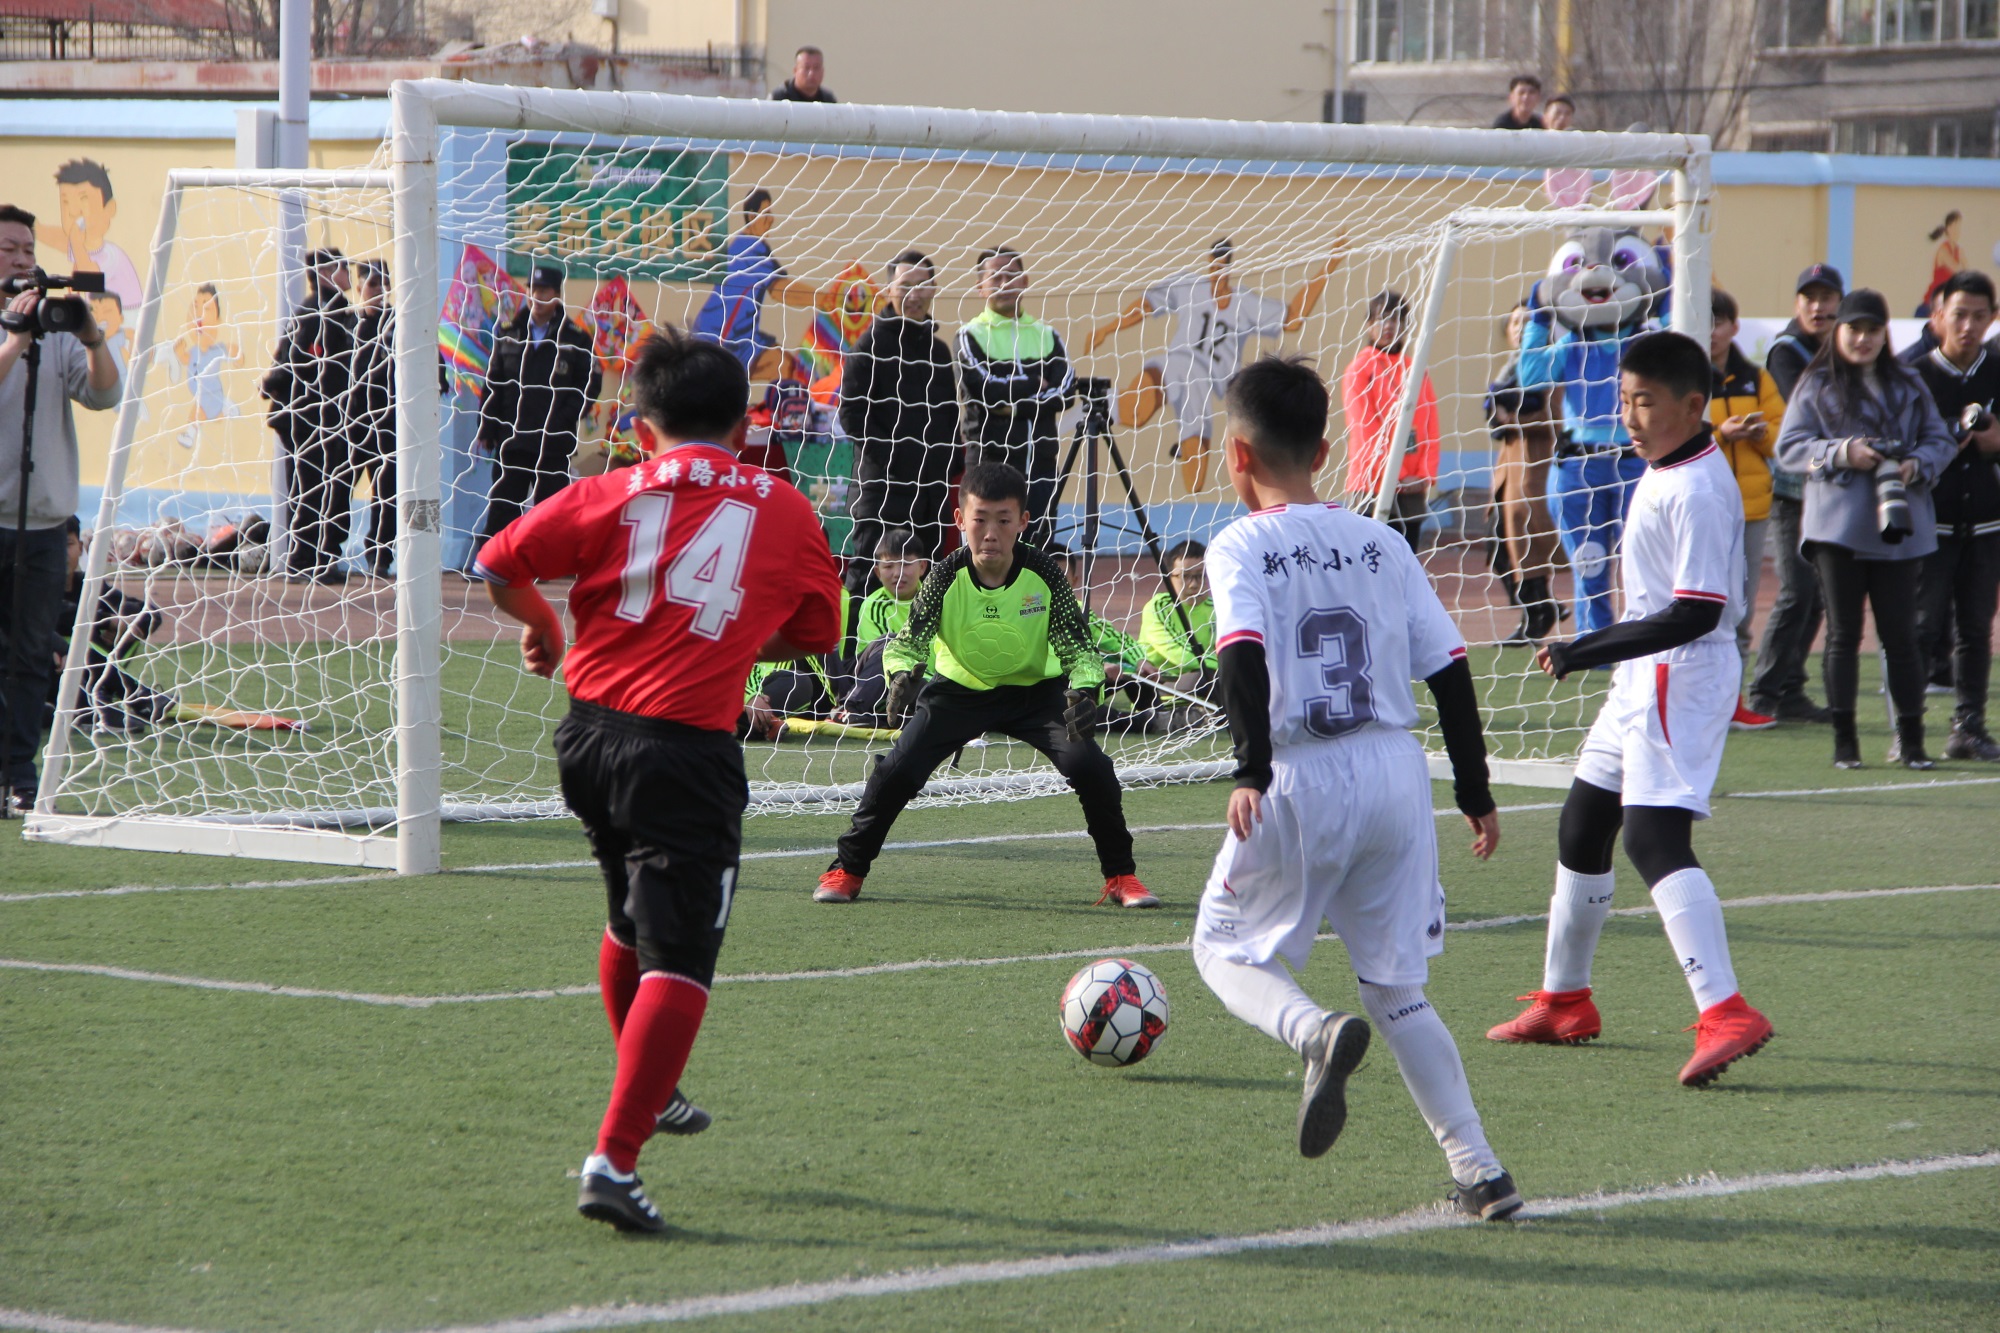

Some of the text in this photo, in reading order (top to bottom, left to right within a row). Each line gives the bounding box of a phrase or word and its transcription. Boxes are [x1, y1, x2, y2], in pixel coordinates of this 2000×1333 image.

[514, 204, 714, 259] 奖品兑换区
[1194, 311, 1228, 363] 12
[626, 458, 774, 498] 先锋路小学
[615, 490, 757, 641] 14
[1262, 541, 1382, 578] 新桥小学
[1296, 606, 1379, 740] 3
[1388, 1001, 1431, 1021] LOOKS
